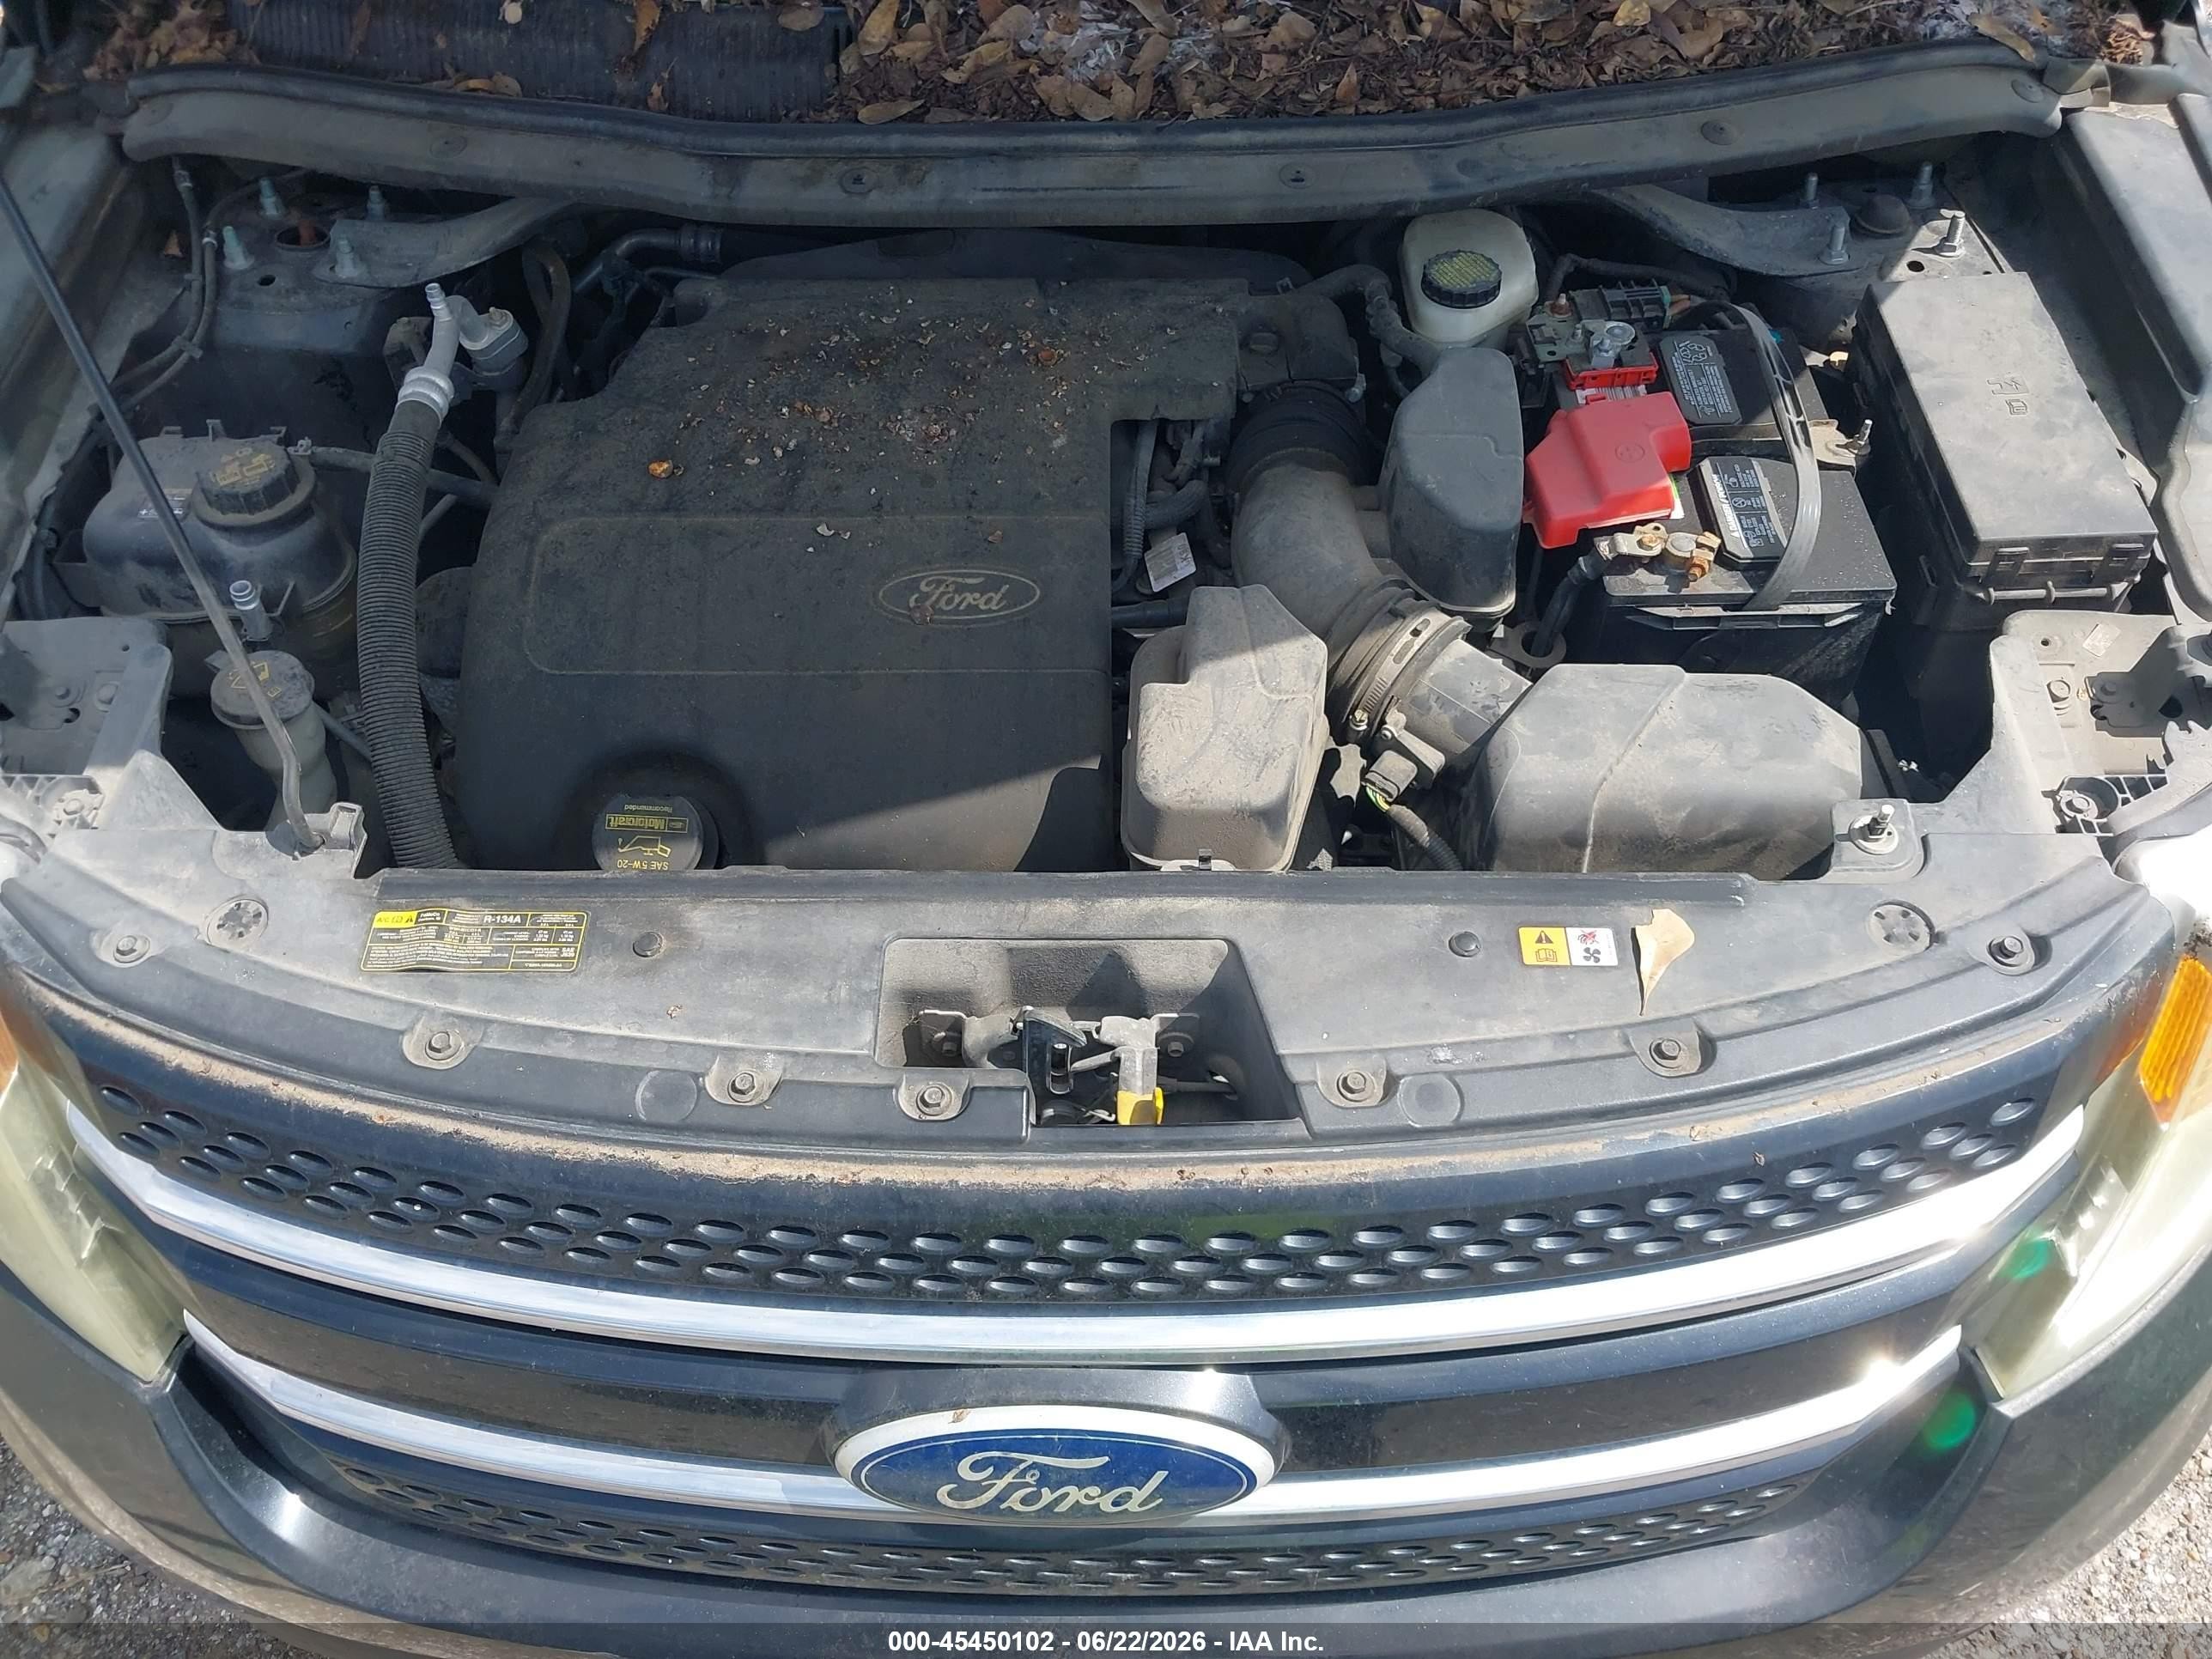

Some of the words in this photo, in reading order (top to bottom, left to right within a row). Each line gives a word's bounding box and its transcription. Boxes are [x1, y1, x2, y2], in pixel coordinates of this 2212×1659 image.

[909, 576, 1010, 611] Ford
[609, 816, 665, 830] Motorcraft
[617, 859, 648, 870] 5W-20
[650, 861, 669, 871] SAE
[483, 915, 522, 924] R-134A
[936, 1450, 1169, 1513] Ford
